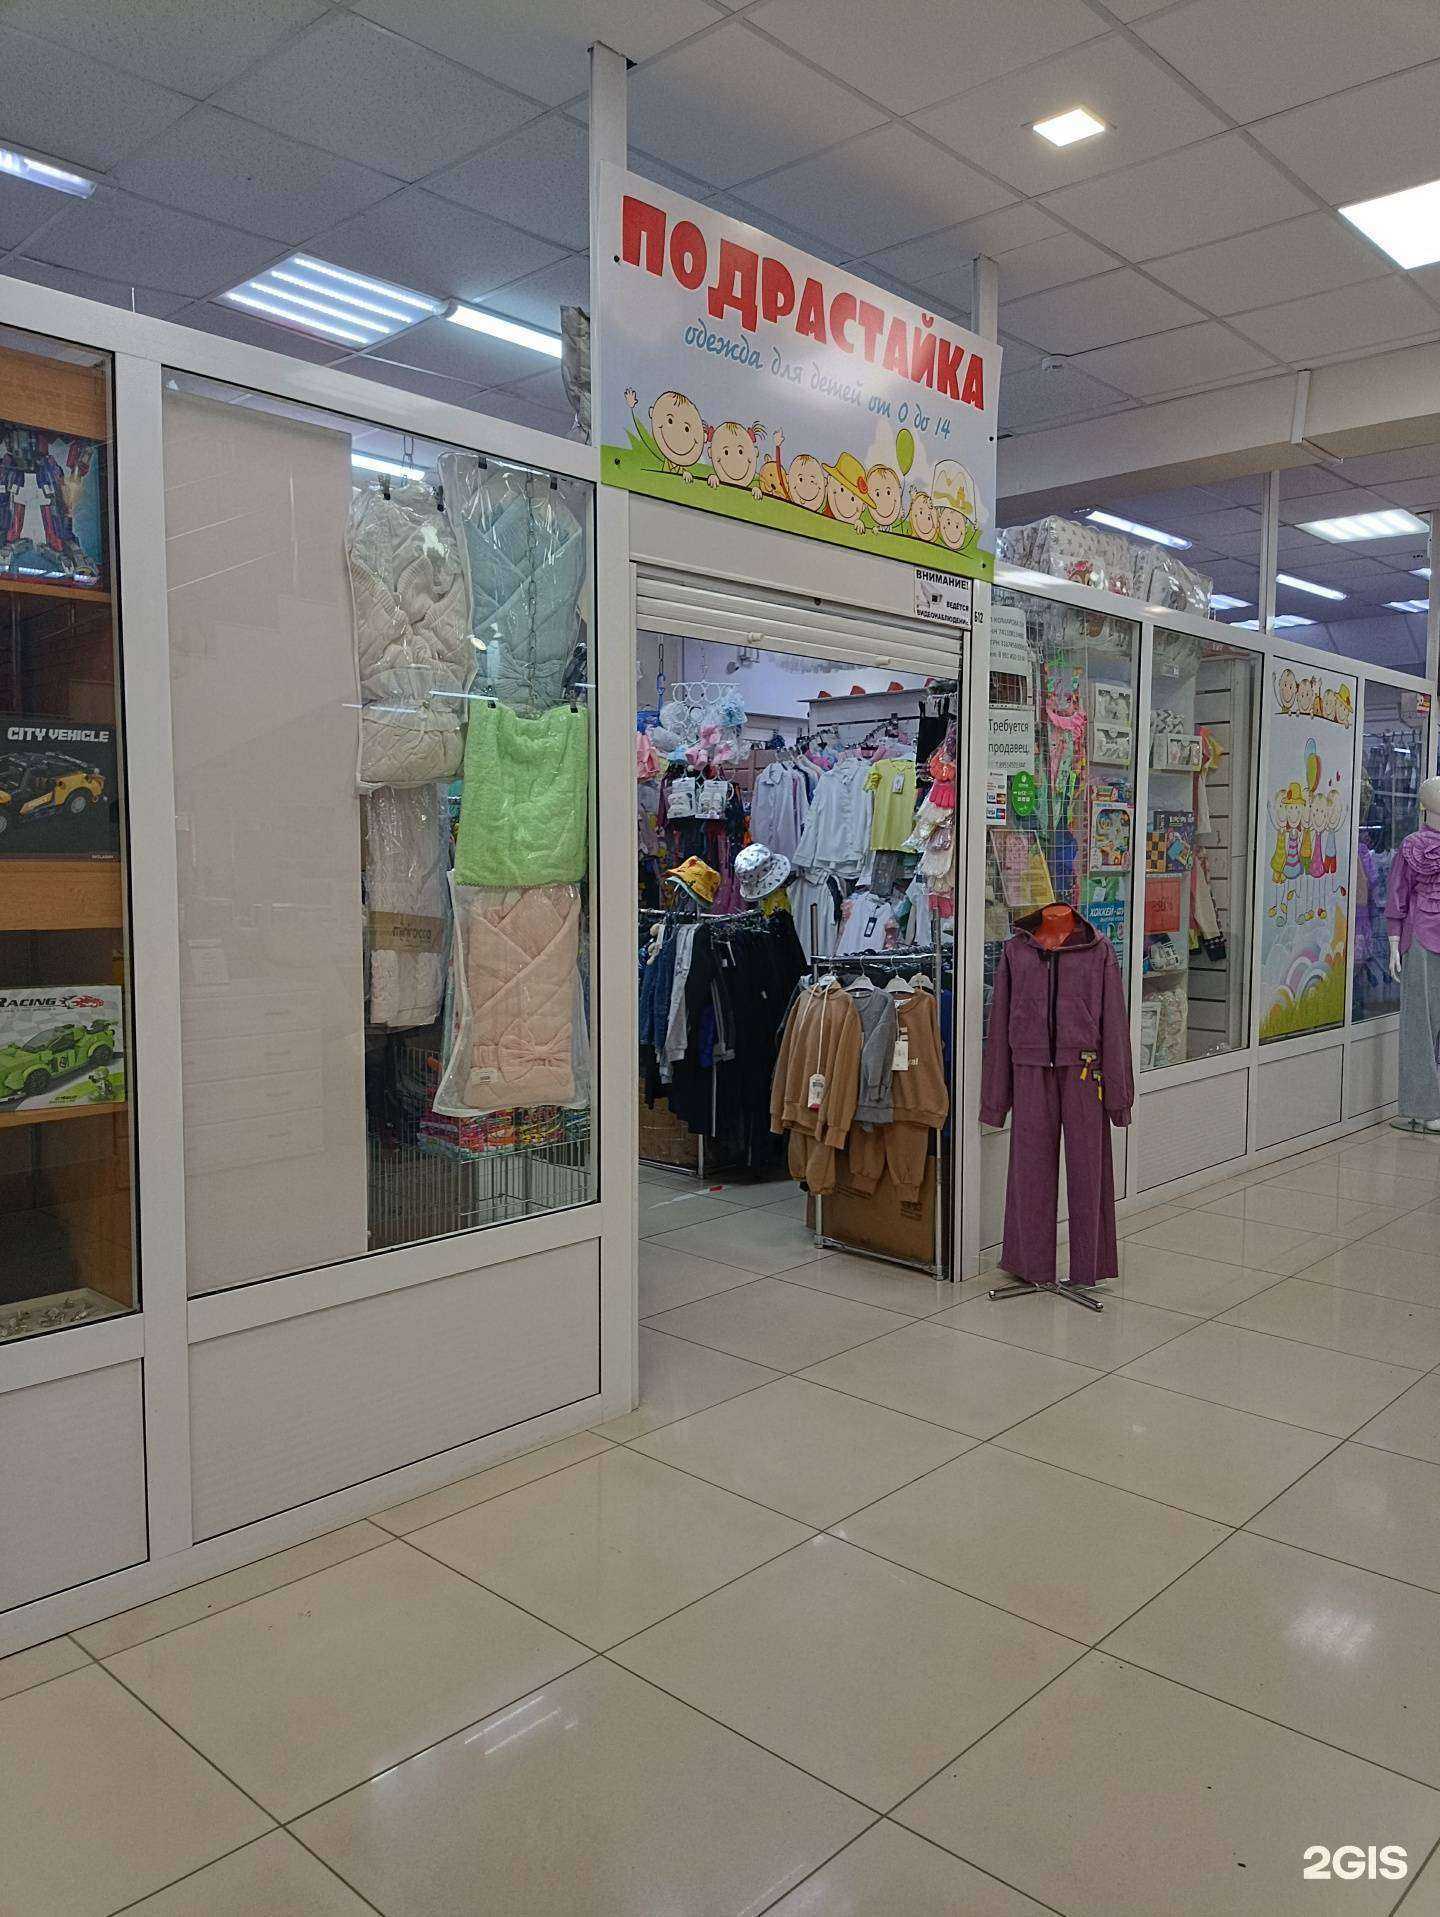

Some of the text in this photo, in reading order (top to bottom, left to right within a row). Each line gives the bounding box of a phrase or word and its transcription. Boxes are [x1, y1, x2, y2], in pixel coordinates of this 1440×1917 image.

[622, 195, 985, 411] ПОДРАСТАЙКА
[685, 318, 764, 369] одежда
[771, 346, 804, 385] для
[810, 361, 864, 406] детей
[868, 395, 891, 418] от
[913, 403, 931, 432] до
[934, 416, 951, 440] 14
[916, 570, 969, 590] ВНИМАНИЕ!
[7, 727, 110, 742] CITY VEHICLE
[989, 718, 1029, 735] Требуется
